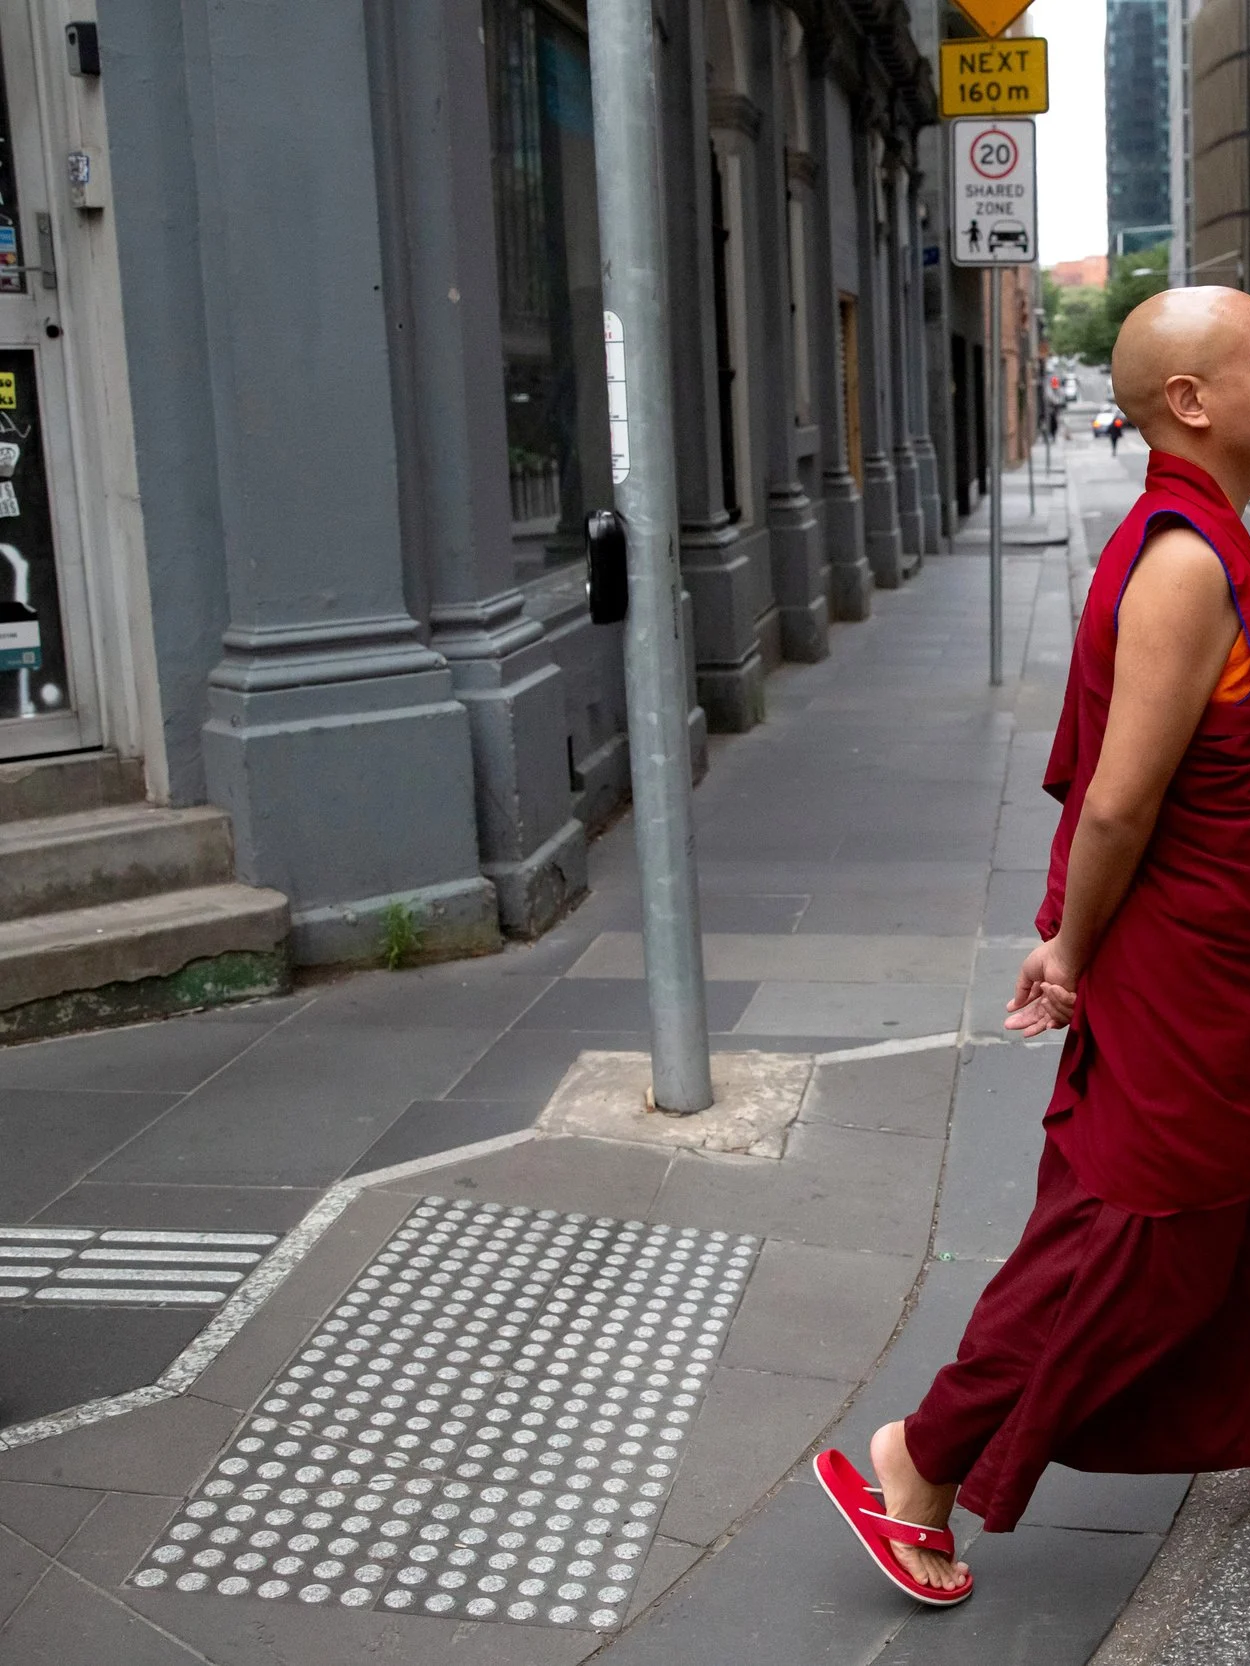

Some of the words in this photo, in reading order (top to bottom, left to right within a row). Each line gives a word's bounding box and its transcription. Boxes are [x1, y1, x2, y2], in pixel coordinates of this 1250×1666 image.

[959, 51, 1030, 74] NEXT
[959, 82, 1001, 102] 160
[1008, 84, 1029, 100] m
[980, 144, 1011, 165] 20
[965, 184, 1025, 198] SHARED
[975, 202, 1014, 216] ZONE
